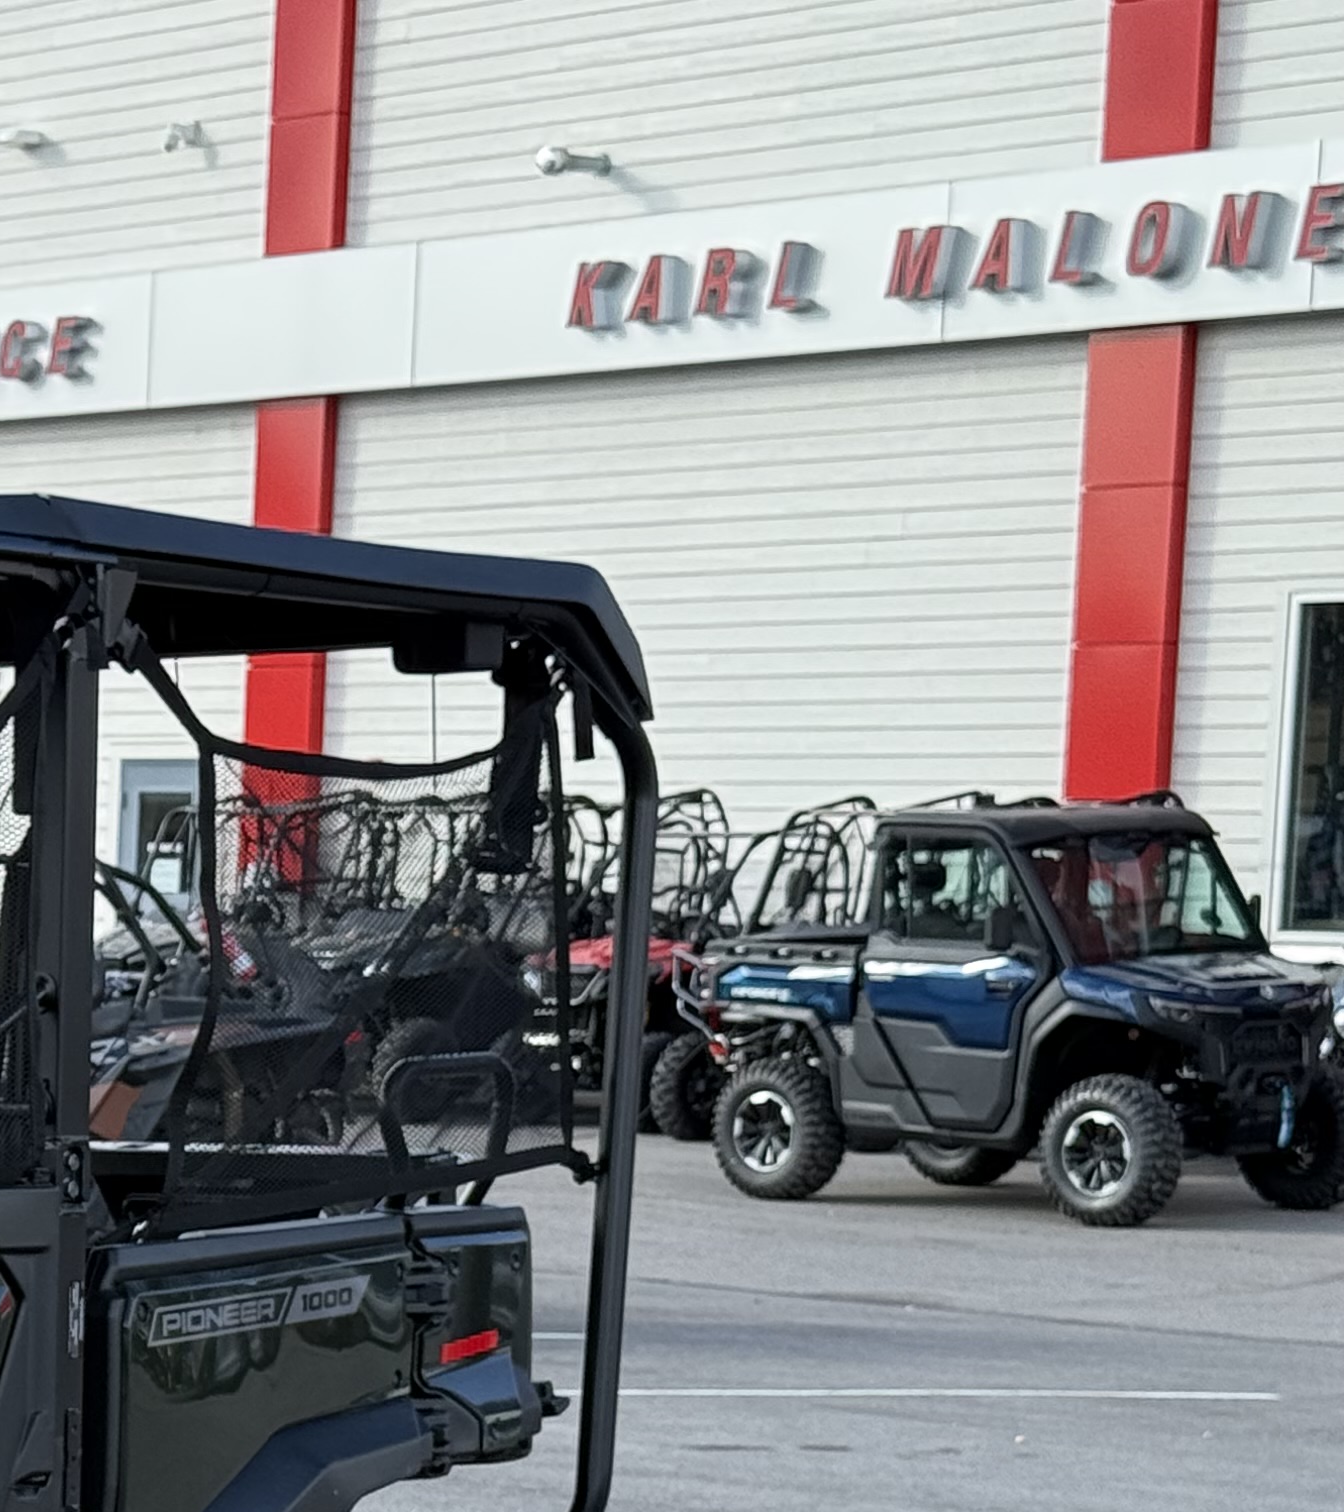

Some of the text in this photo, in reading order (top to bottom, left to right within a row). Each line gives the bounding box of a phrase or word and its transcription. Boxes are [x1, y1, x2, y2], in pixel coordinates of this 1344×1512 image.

[566, 183, 1344, 333] KARL MALONE
[161, 1286, 354, 1338] PIONEER 1000
